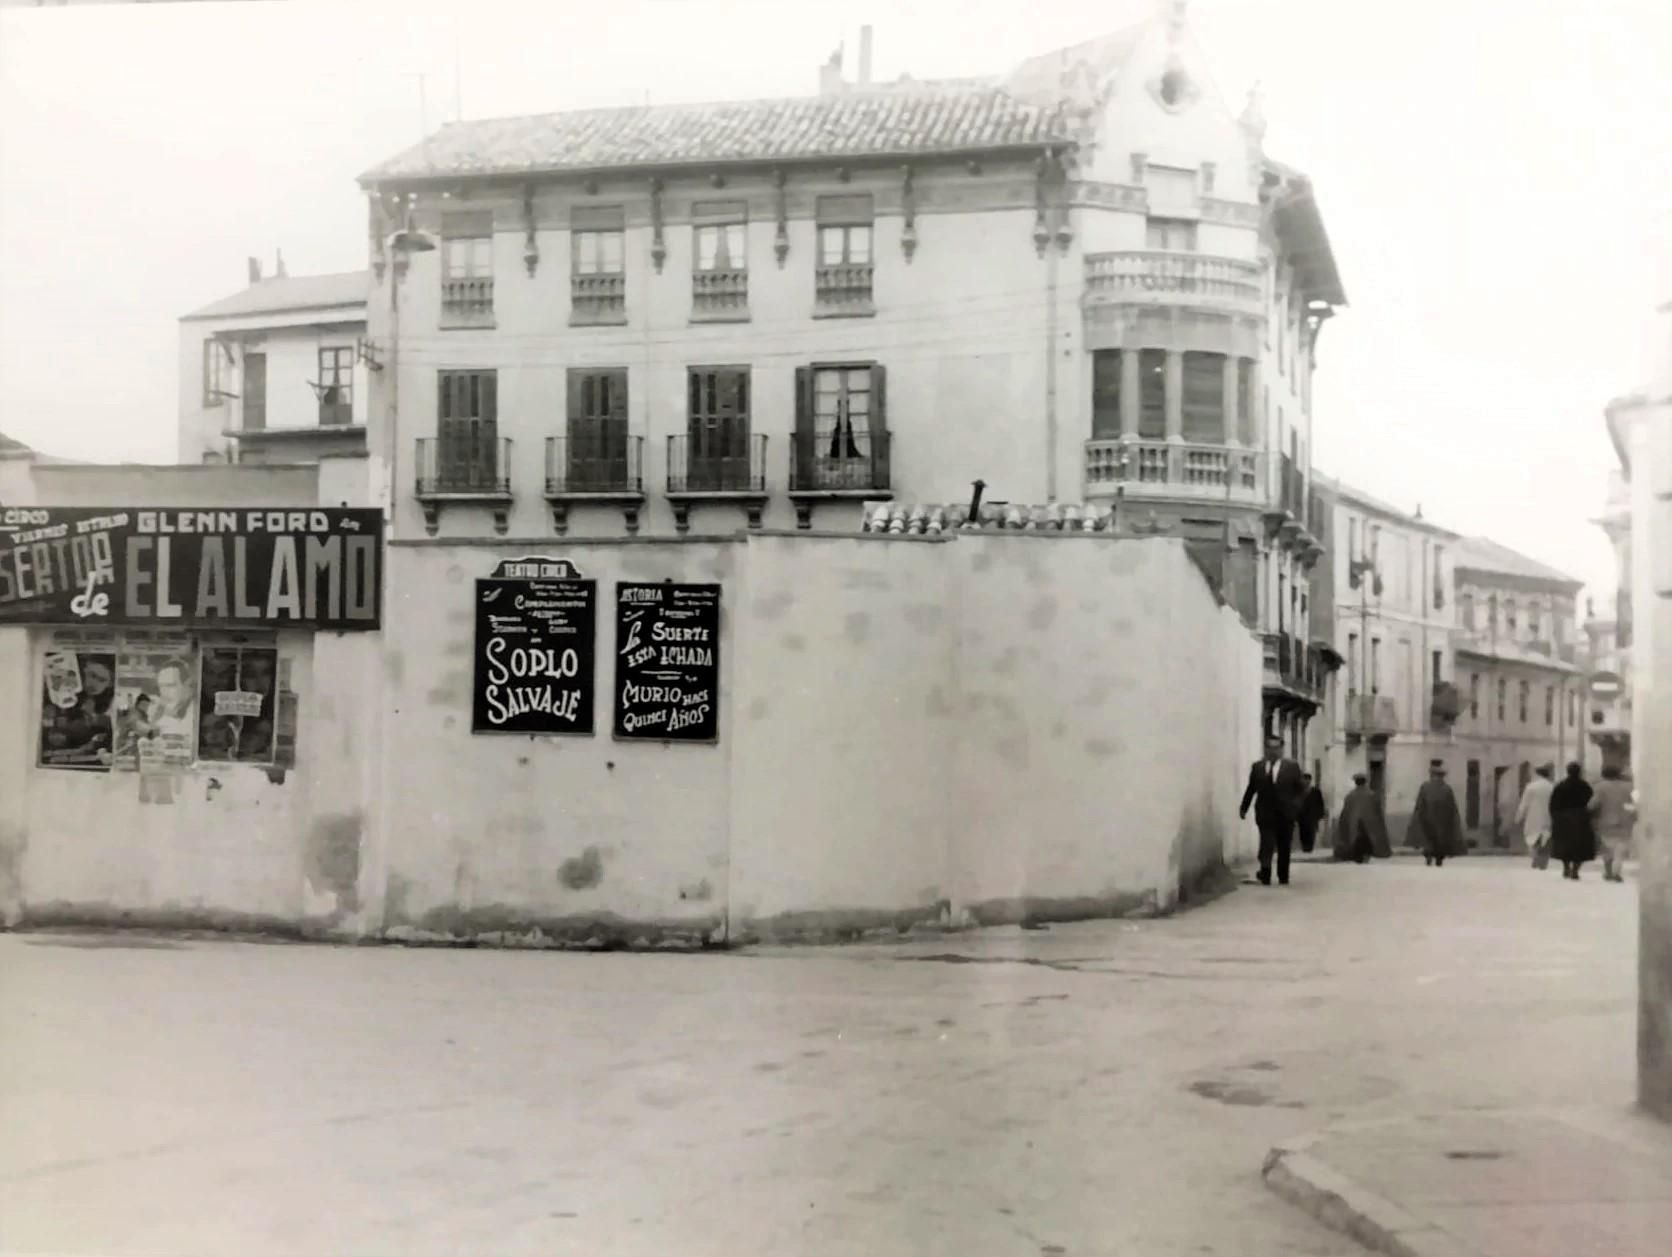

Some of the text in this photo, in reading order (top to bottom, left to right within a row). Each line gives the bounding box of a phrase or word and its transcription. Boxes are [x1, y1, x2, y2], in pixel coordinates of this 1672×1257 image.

[137, 511, 237, 533] GLENN
[247, 512, 329, 533] FORD
[70, 571, 110, 618] de
[125, 535, 376, 619] EL ALAMO
[651, 621, 710, 641] SUERTE
[486, 637, 578, 685] SOPLO
[485, 684, 581, 724] SALVAJE
[622, 679, 682, 709] MURIO
[667, 704, 710, 731] AÑOS
